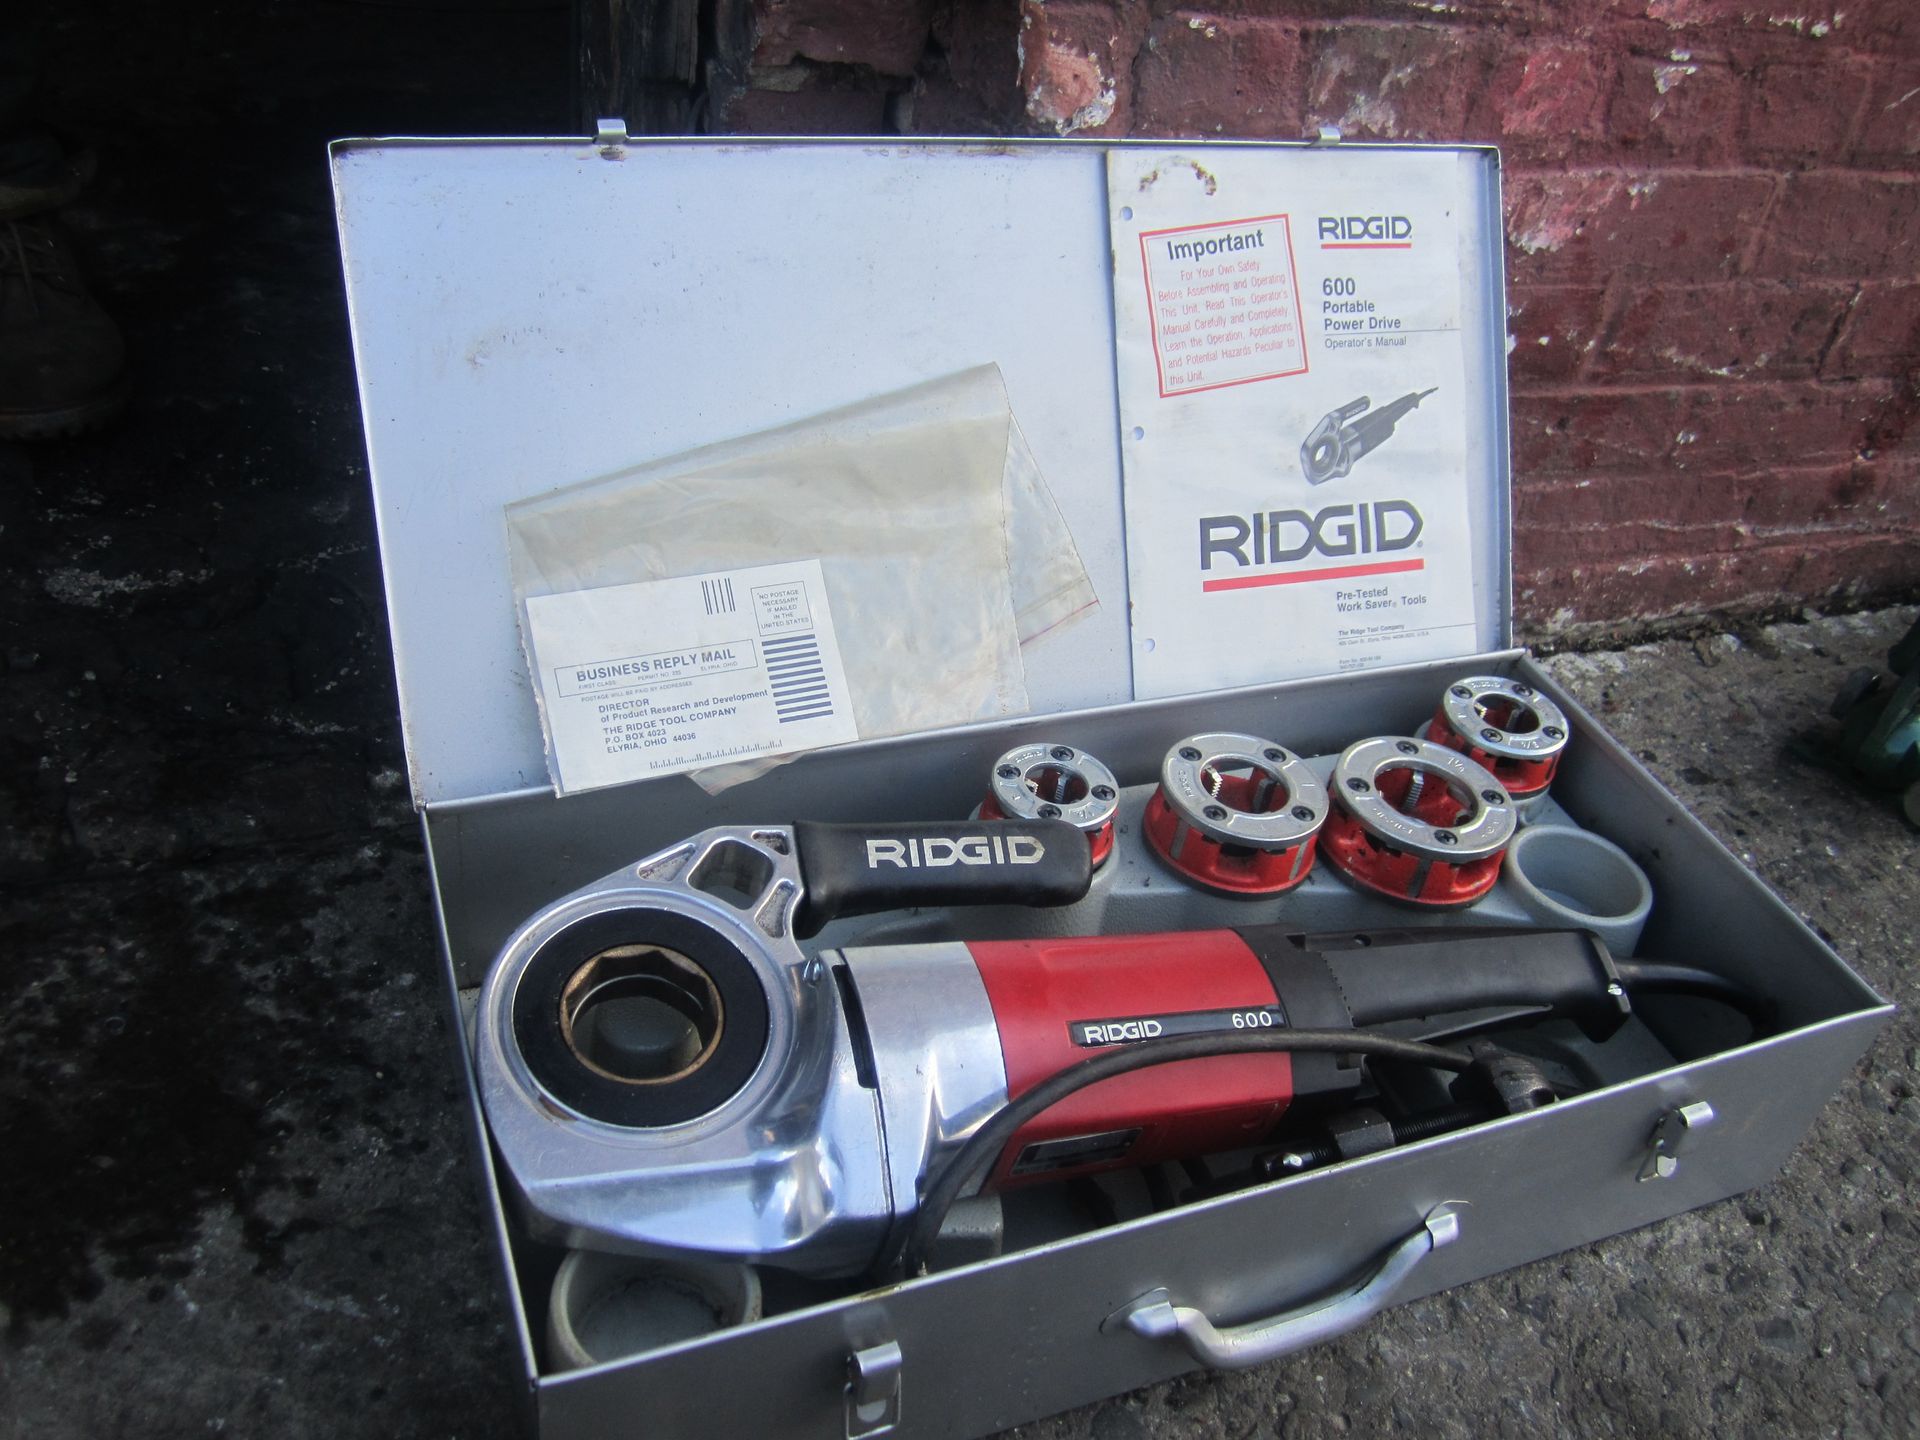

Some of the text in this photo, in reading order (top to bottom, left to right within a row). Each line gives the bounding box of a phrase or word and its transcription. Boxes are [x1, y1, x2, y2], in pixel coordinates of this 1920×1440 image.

[1318, 216, 1412, 240] RIDGID
[1167, 229, 1264, 262] Important
[1181, 260, 1260, 281] For Your Own Safety
[1159, 273, 1286, 301] Before Assembling and Operating
[1322, 277, 1355, 296] 600
[1161, 308, 1177, 318] This
[1206, 300, 1224, 311] Read
[1231, 296, 1246, 307] This
[1323, 300, 1375, 313] Portable
[1162, 306, 1288, 336] Manual Carefully and Completely
[1324, 316, 1401, 331] Power Drive
[1165, 341, 1186, 353] Learn
[1190, 338, 1202, 348] the
[1250, 322, 1293, 337] Applications
[1325, 336, 1407, 350] Operator's Manual
[1168, 338, 1295, 369] and Potential Hazards Peculiar to
[1170, 374, 1184, 385] this
[1199, 499, 1424, 570] RIDGID
[762, 597, 798, 607] NECESSARY
[770, 589, 799, 598] POSTAGE
[1336, 587, 1388, 600] Pre-Tested
[1337, 602, 1362, 612] Work
[1401, 595, 1427, 606] Tools
[774, 604, 797, 612] MAILED
[761, 617, 809, 629] UNITED STATES
[576, 648, 736, 682] BUSINESS REPLY MAIL
[598, 698, 650, 713] DIRECTOR
[601, 689, 768, 723] of Product Research and Development
[603, 707, 737, 735] THE RIDGE TOOL COMPANY
[605, 728, 666, 744] P.O. BOX 4023
[607, 732, 696, 753] ELYRIA, OHIO 44036
[866, 836, 1045, 868] RIDGID
[1083, 1011, 1272, 1044] RIDGID 600
